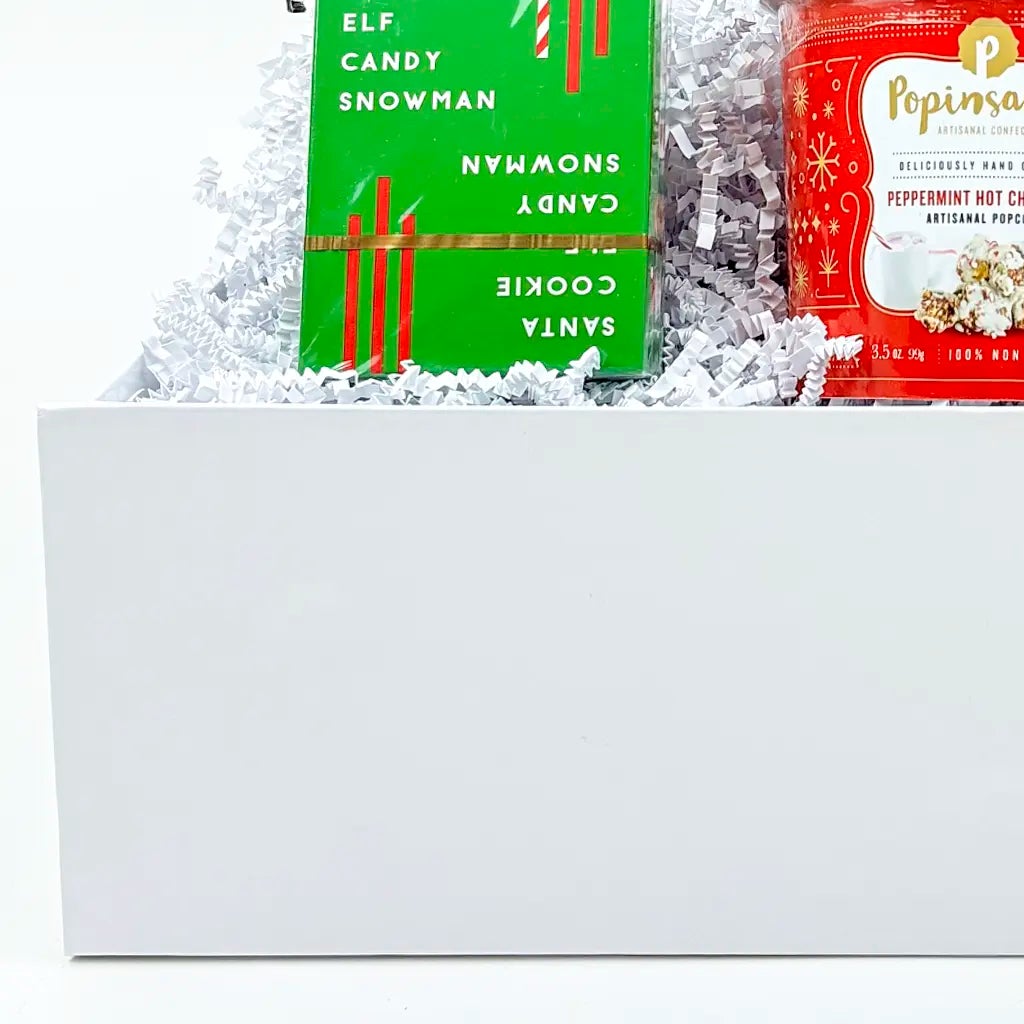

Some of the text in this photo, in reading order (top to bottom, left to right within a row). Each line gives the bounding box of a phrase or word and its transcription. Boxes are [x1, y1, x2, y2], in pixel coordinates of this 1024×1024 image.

[342, 12, 394, 32] ELF
[341, 51, 442, 72] CANDY
[339, 89, 496, 112] SNOWMAN
[937, 125, 986, 136] ARTISANAL
[461, 153, 621, 175] SNOWMAN
[899, 161, 976, 172] DELICIOUSLY
[982, 161, 1014, 172] HAND
[517, 193, 619, 215] CANDY
[887, 190, 971, 207] PEPPERMINT
[976, 190, 1004, 207] HOT
[926, 212, 987, 225] ARTISANAL
[496, 276, 618, 297] COOKIE
[522, 317, 616, 338] SANTA
[871, 343, 890, 360] 3.5
[908, 347, 925, 362] 99g
[948, 348, 983, 361] 100%
[991, 348, 1020, 361] NON
